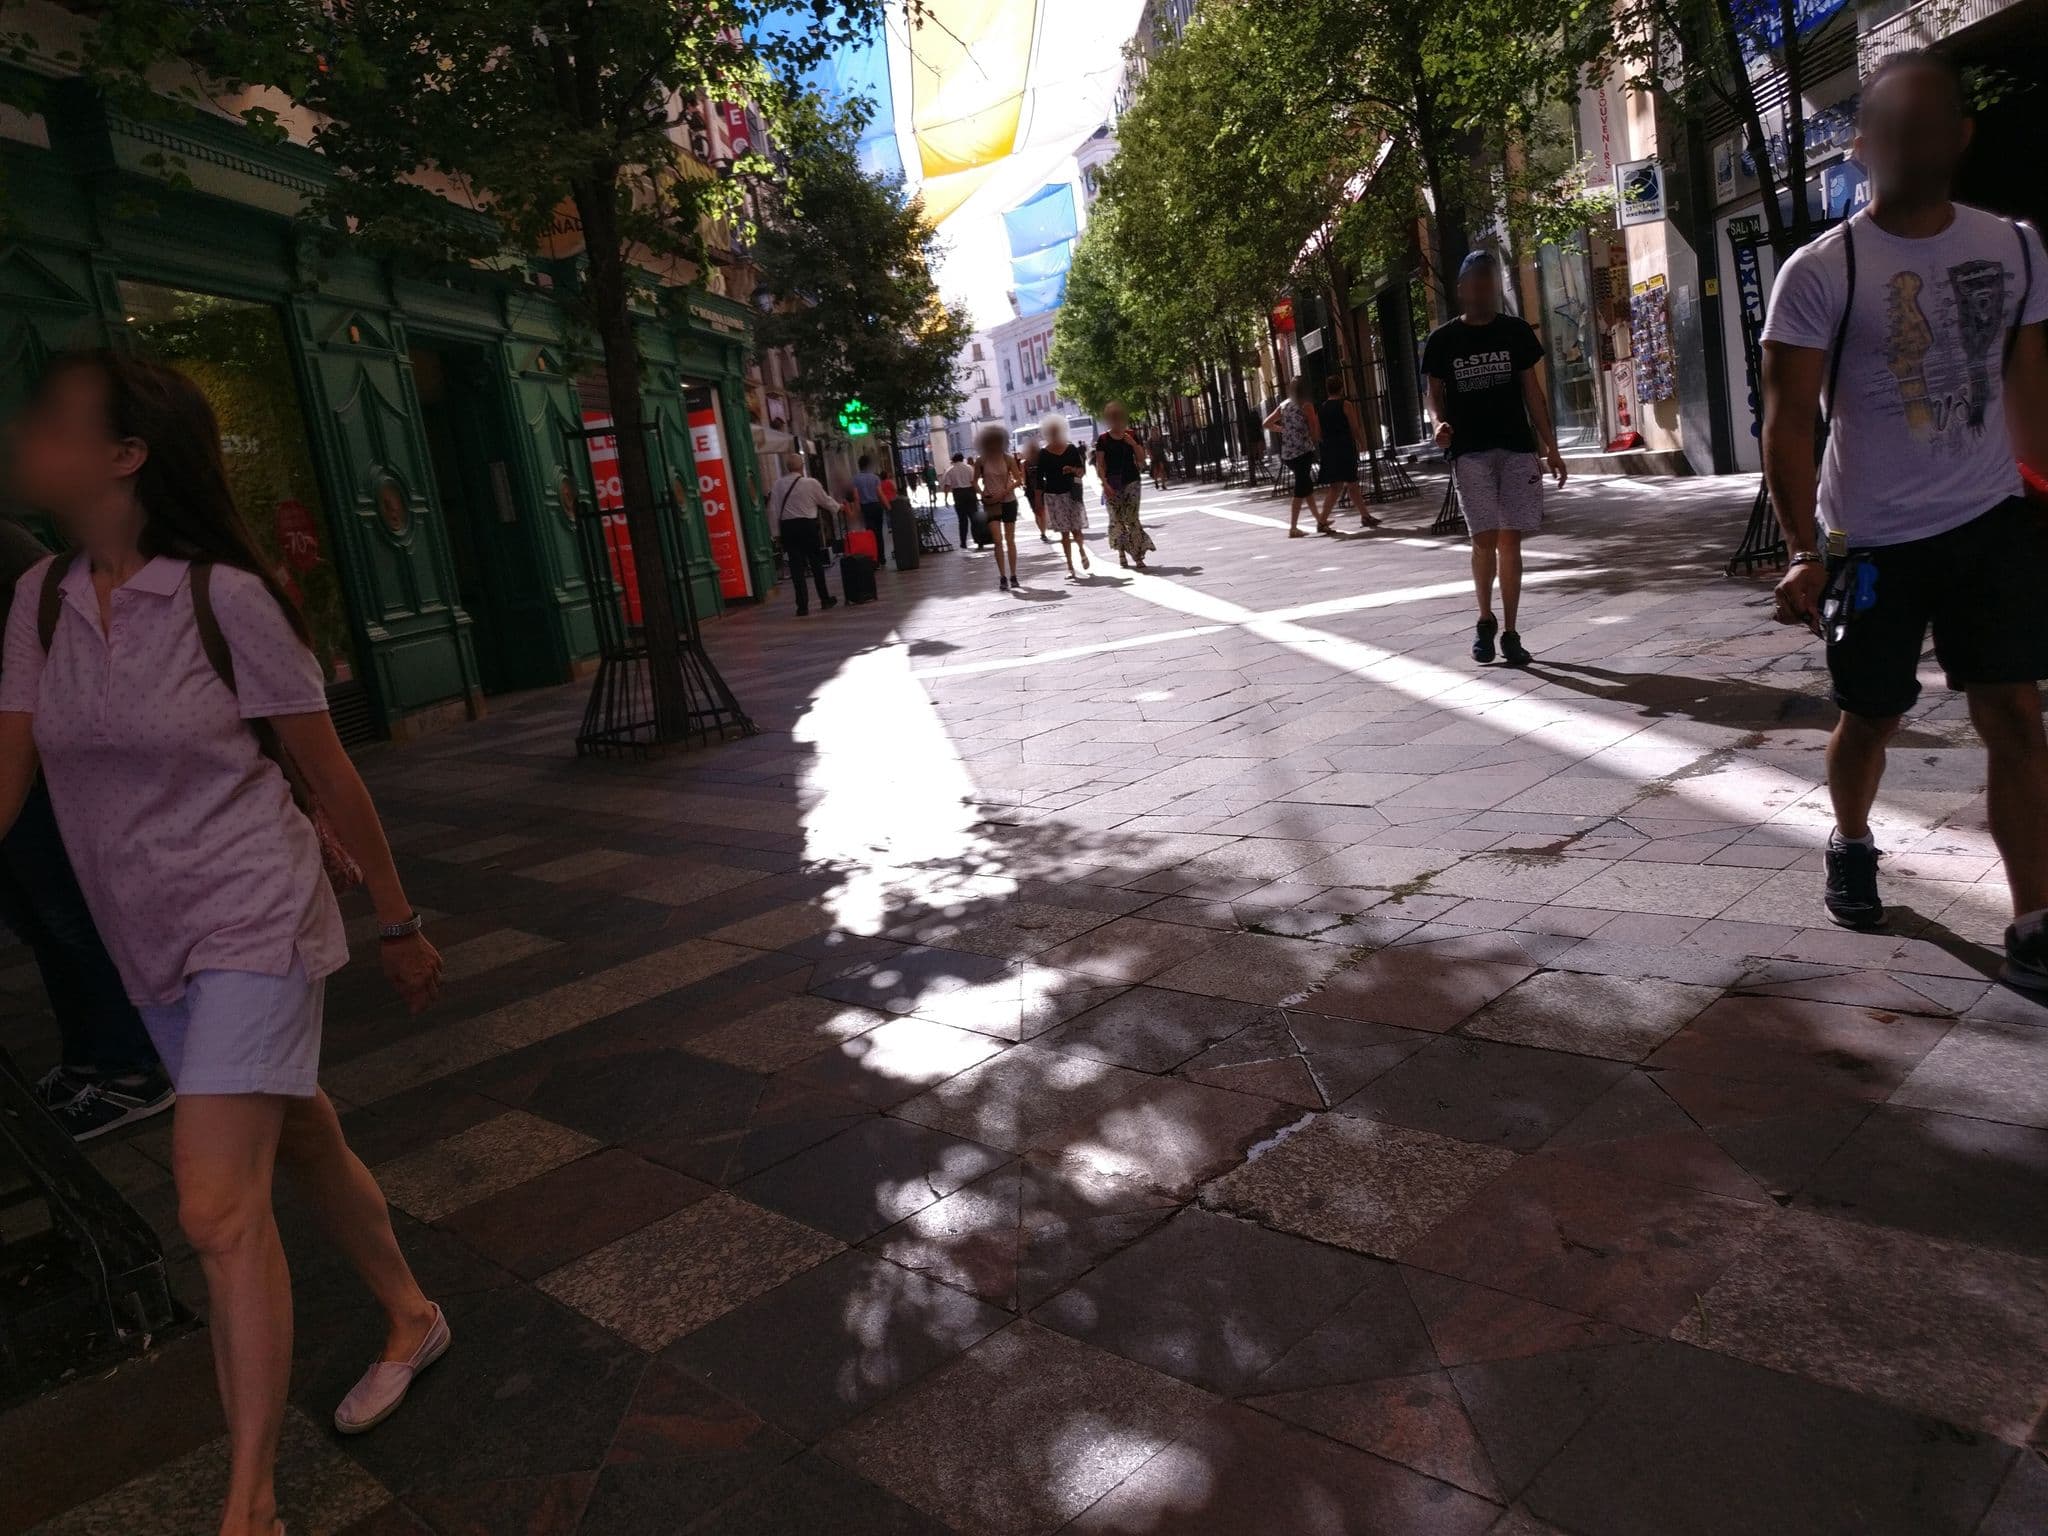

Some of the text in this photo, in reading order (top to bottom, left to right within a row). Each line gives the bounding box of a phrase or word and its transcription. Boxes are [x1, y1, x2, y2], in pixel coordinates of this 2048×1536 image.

[1600, 89, 1612, 169] SOUVENIRS
[1453, 350, 1511, 369] G-STAR
[1455, 363, 1511, 378] ORIGINALS
